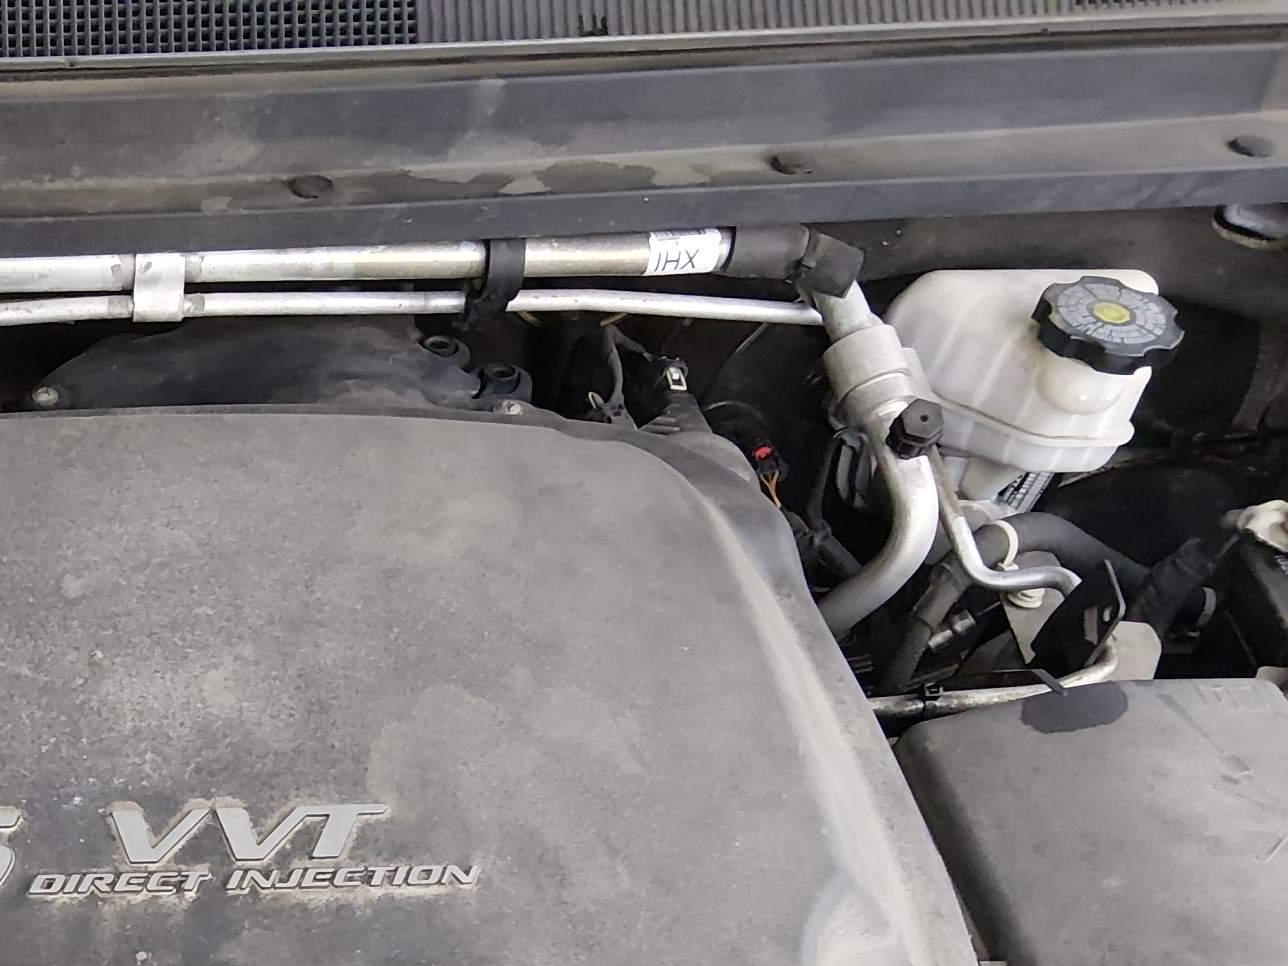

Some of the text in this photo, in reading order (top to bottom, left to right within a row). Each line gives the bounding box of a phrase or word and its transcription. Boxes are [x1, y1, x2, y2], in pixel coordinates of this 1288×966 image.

[111, 802, 389, 863] VVT
[27, 862, 481, 896] DIRECT INJECTION
